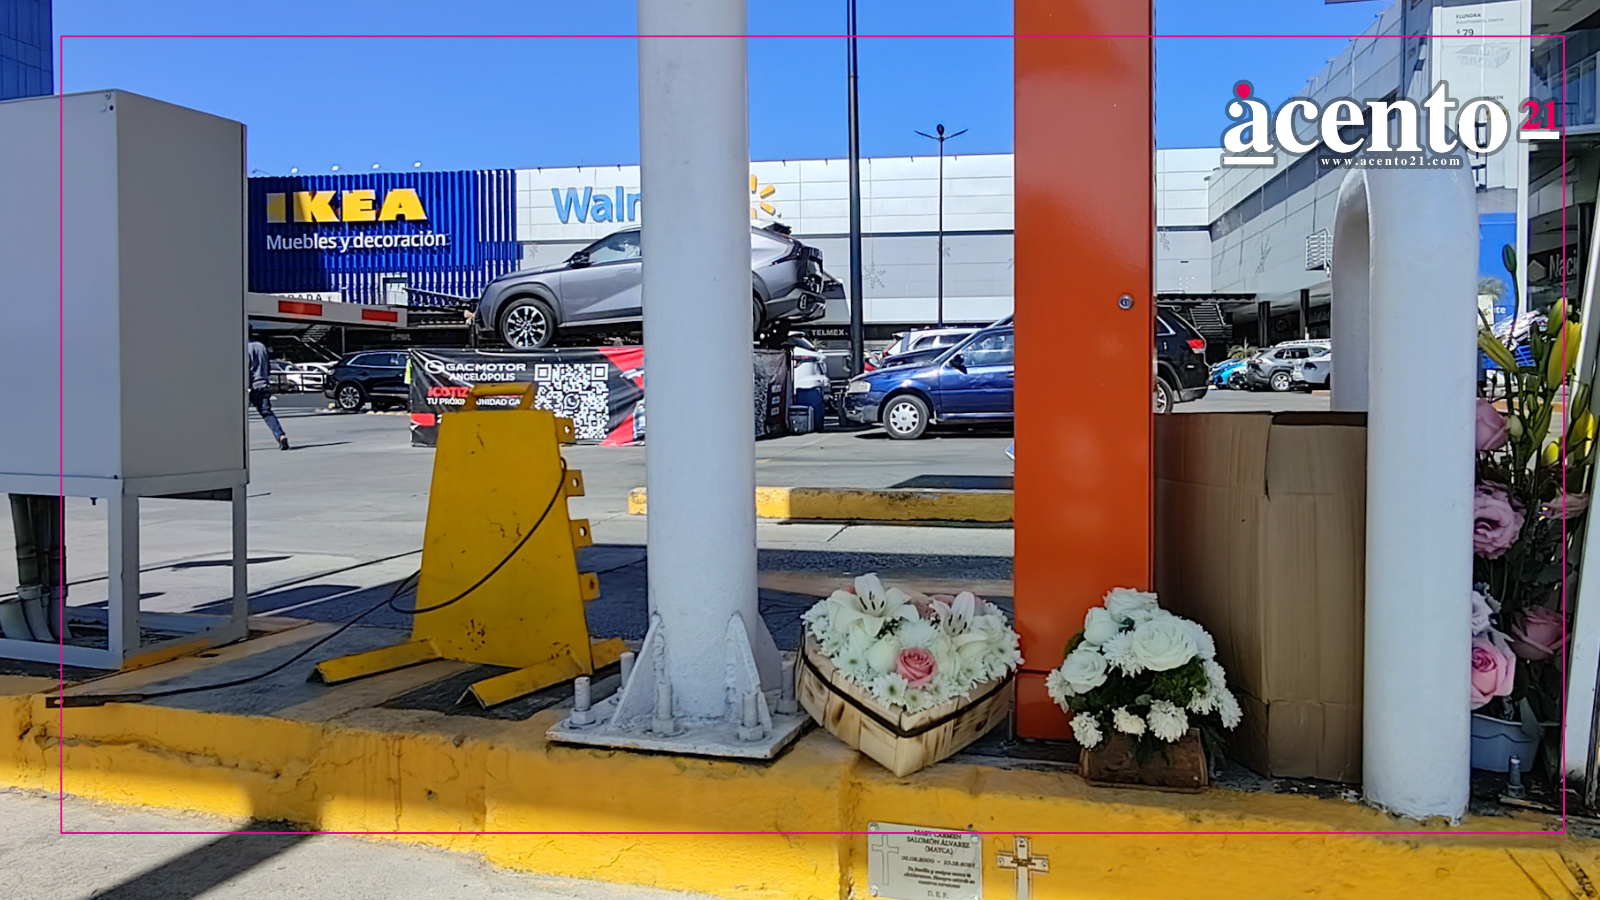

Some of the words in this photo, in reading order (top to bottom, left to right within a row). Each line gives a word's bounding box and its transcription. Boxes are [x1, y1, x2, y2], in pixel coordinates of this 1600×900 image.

[266, 188, 428, 223] IKEA
[266, 233, 337, 250] Muebles
[340, 236, 351, 253] y
[353, 231, 447, 249] decoración
[449, 372, 516, 381] ANGELÓPOLIS
[508, 398, 521, 406] GA
